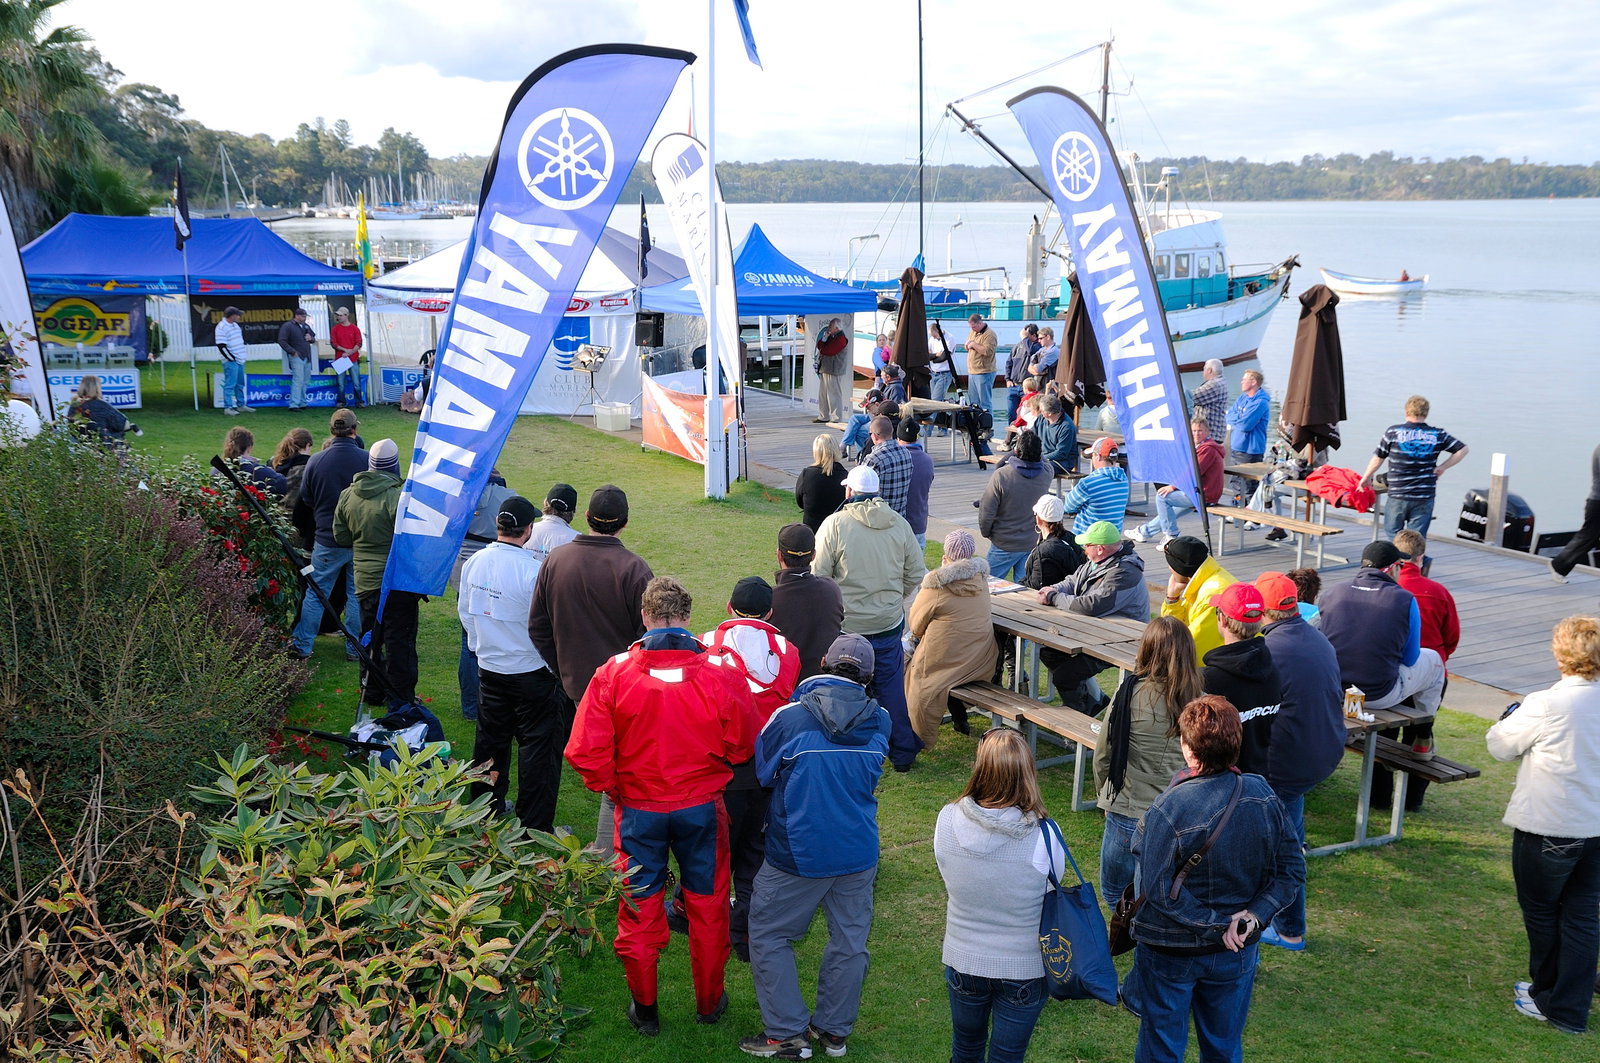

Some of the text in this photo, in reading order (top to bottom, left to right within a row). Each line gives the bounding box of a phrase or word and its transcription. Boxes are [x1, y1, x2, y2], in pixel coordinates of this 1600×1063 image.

[758, 273, 815, 284] YAMAHA
[412, 300, 450, 311] Berkley
[394, 211, 578, 537] YAMAHA
[554, 374, 590, 384] CLUB
[48, 375, 133, 385] GEEONG
[103, 393, 135, 404] ENTRE
[250, 391, 282, 401] We're
